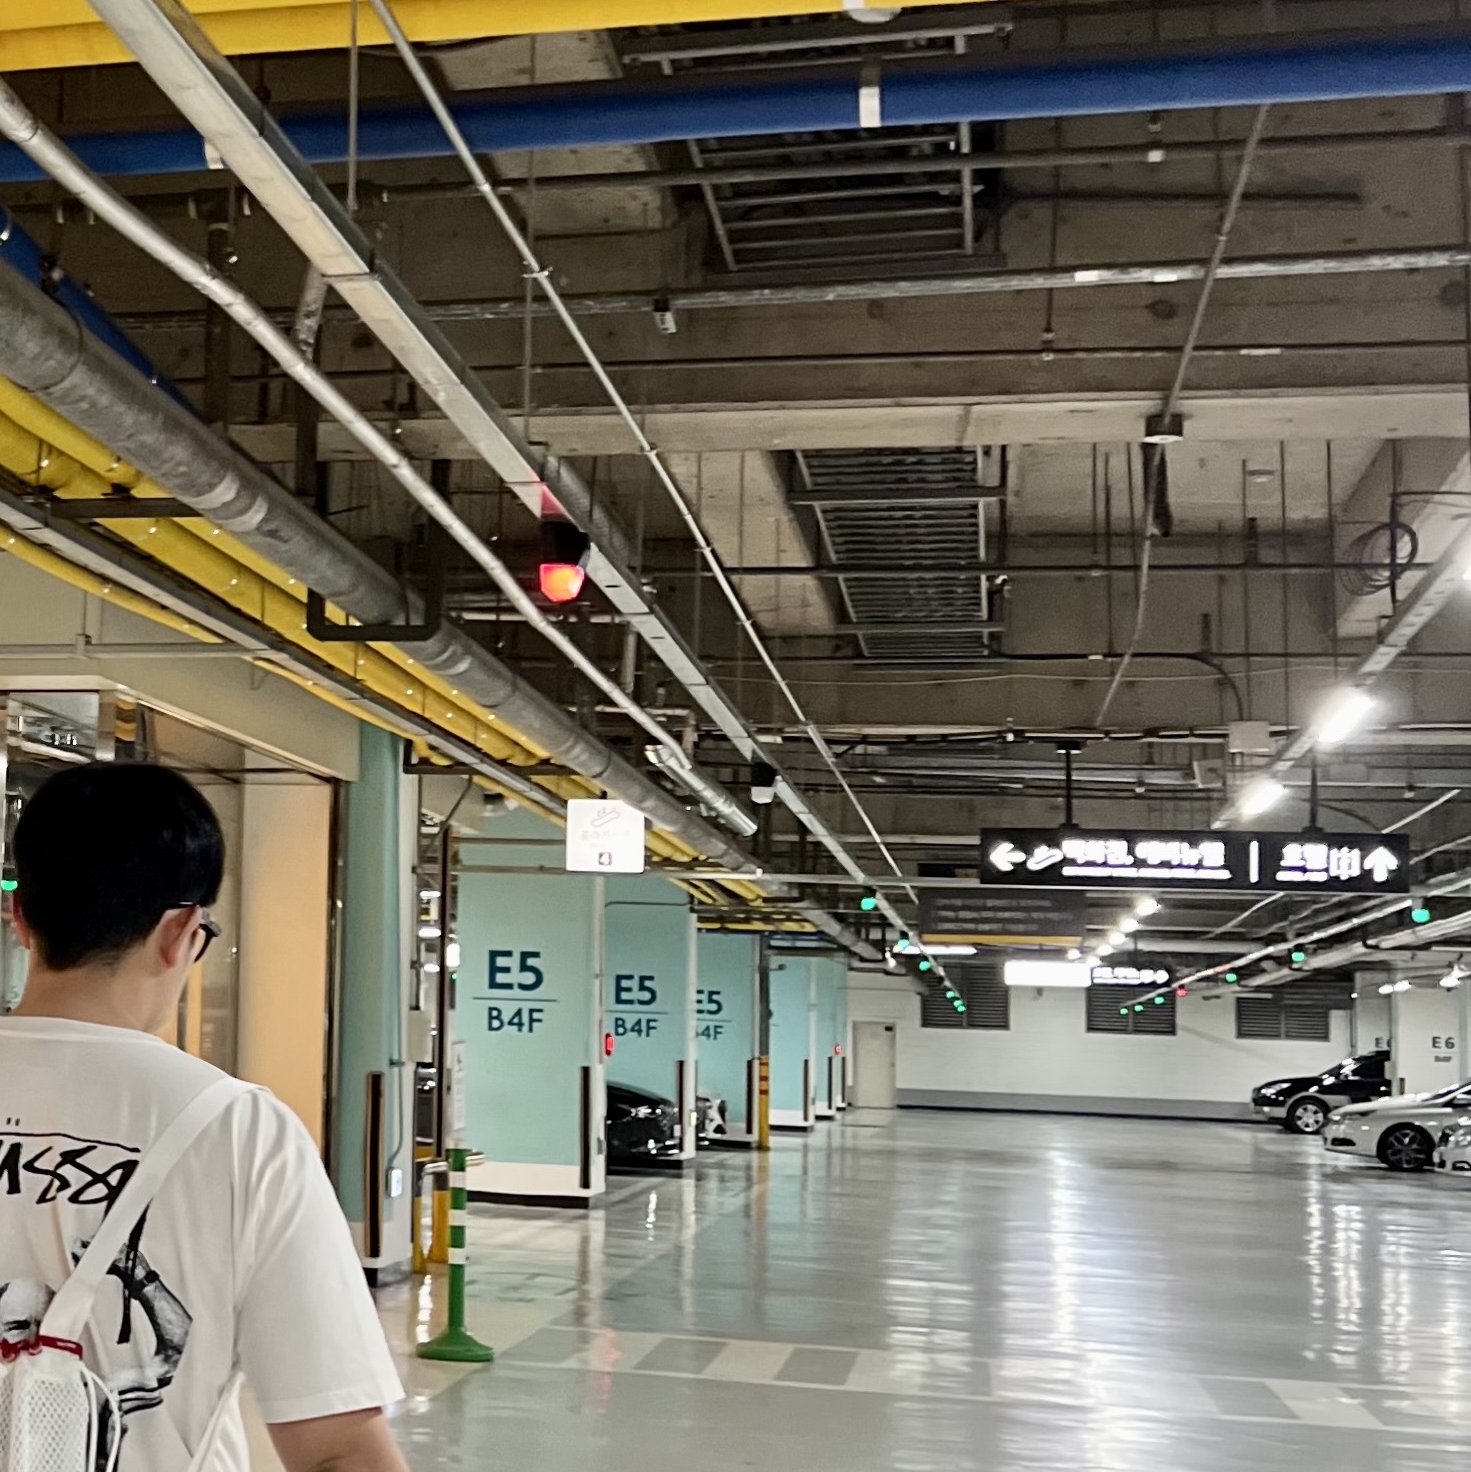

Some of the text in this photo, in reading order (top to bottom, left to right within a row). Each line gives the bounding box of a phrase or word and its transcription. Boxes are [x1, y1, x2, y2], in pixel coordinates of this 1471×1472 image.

[488, 950, 544, 991] E5
[615, 974, 657, 1006] E5
[488, 1006, 544, 1033] B4F
[614, 1017, 658, 1037] B4F
[696, 1024, 724, 1040] 4F
[1432, 1036, 1455, 1050] E6
